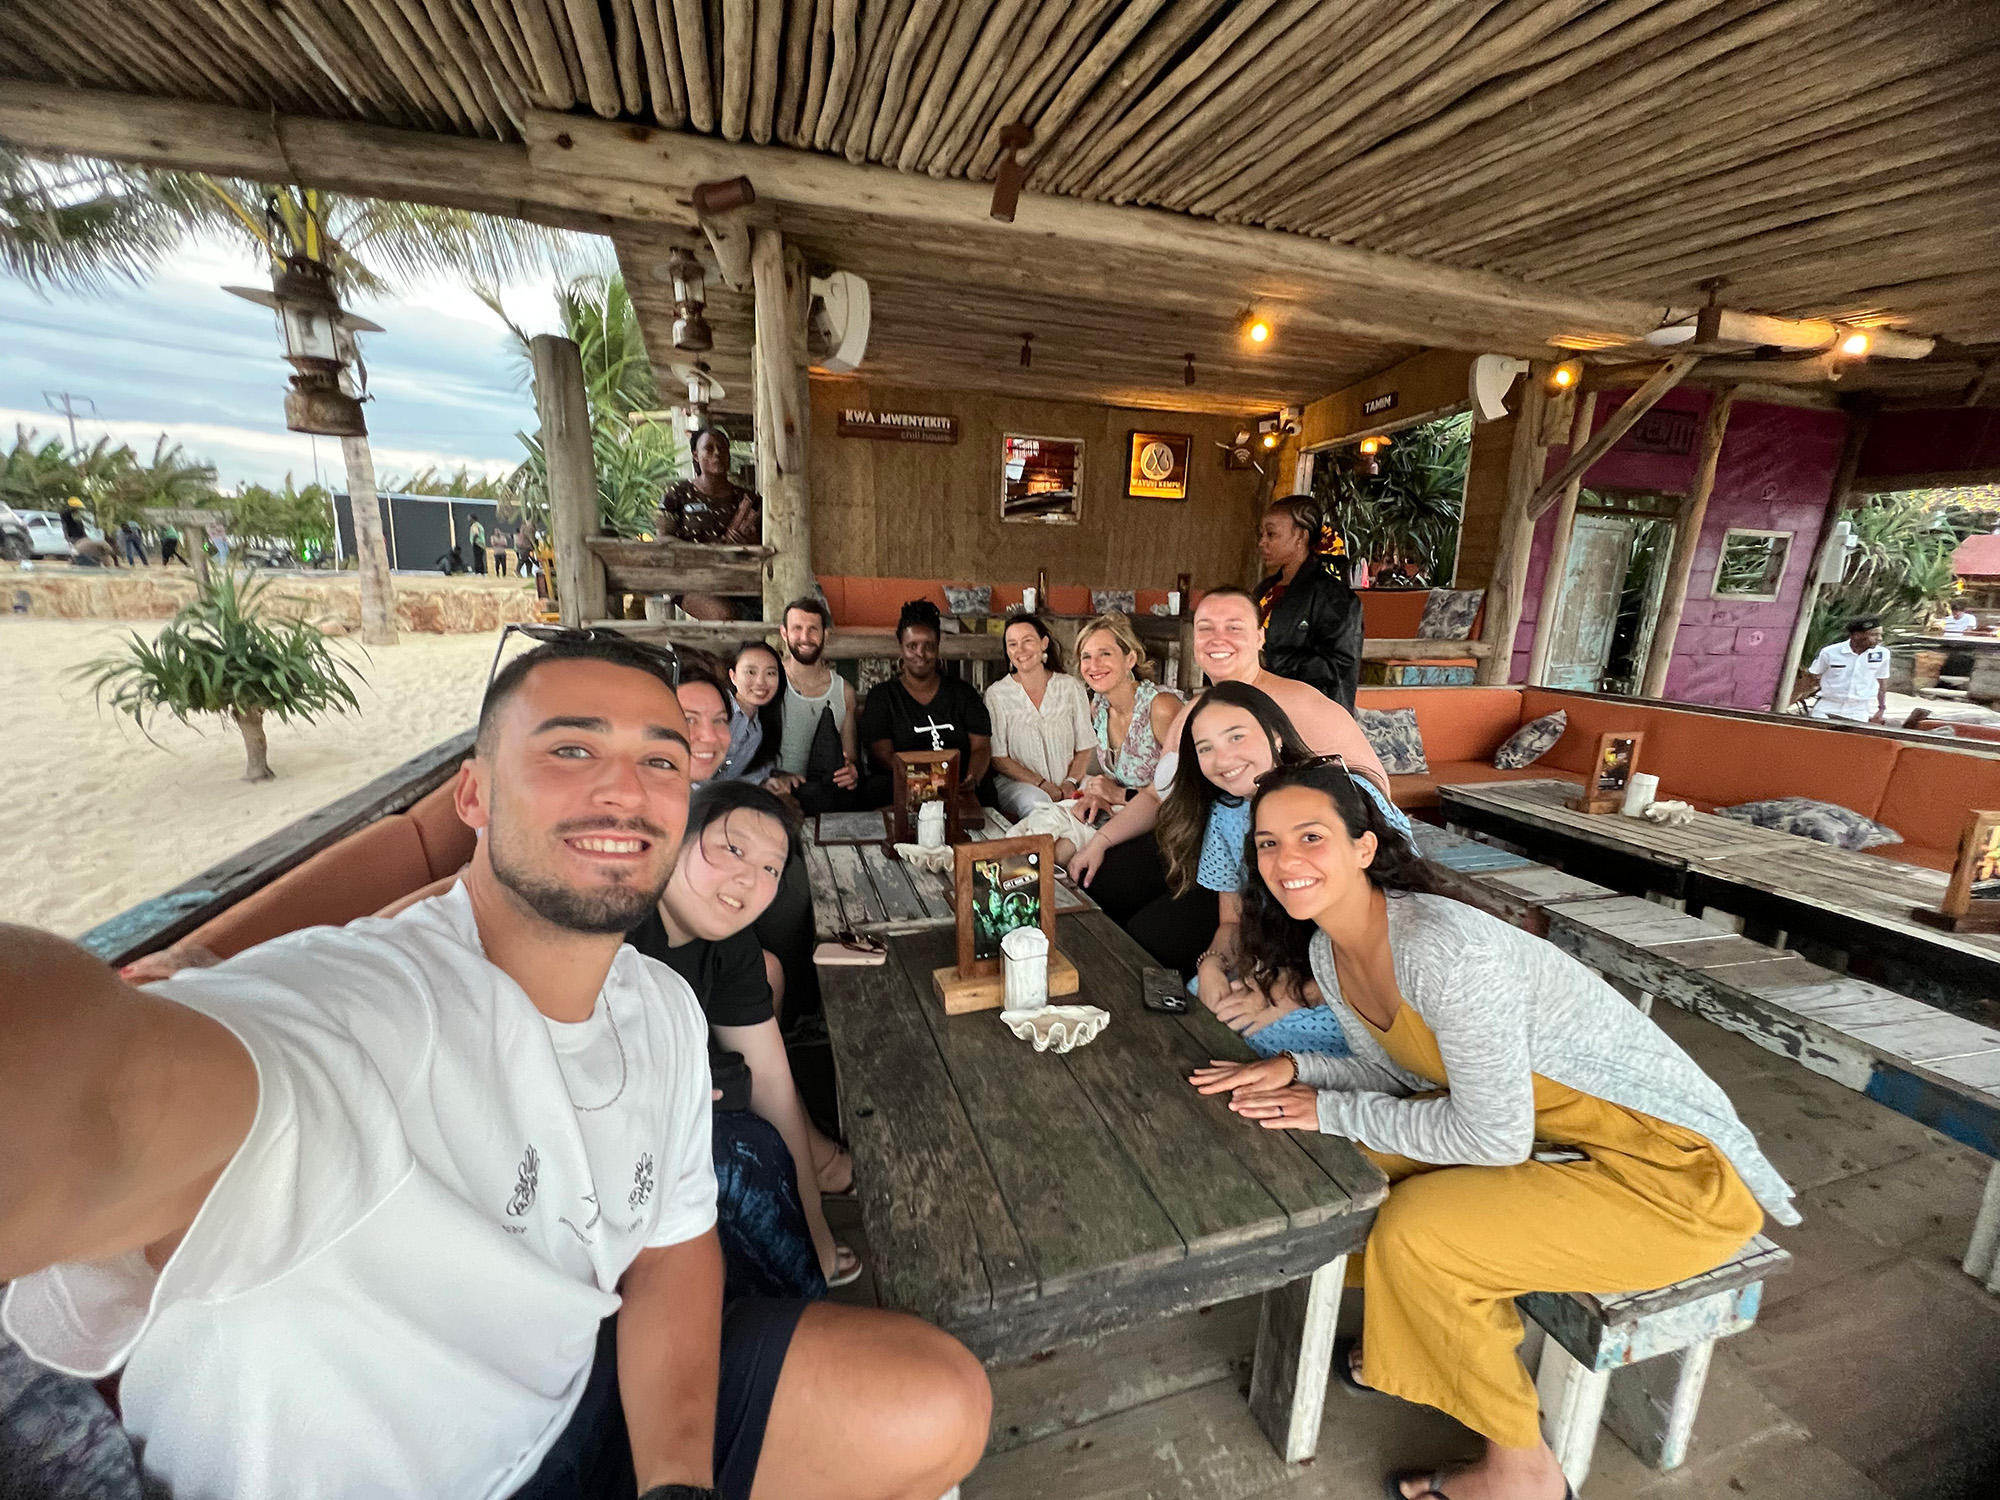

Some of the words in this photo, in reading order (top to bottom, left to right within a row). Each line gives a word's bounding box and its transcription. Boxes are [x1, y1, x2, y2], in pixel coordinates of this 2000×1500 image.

[845, 409, 875, 423] KWA
[880, 412, 950, 429] MWENYEKITI
[901, 430, 920, 440] chill
[922, 431, 951, 442] house
